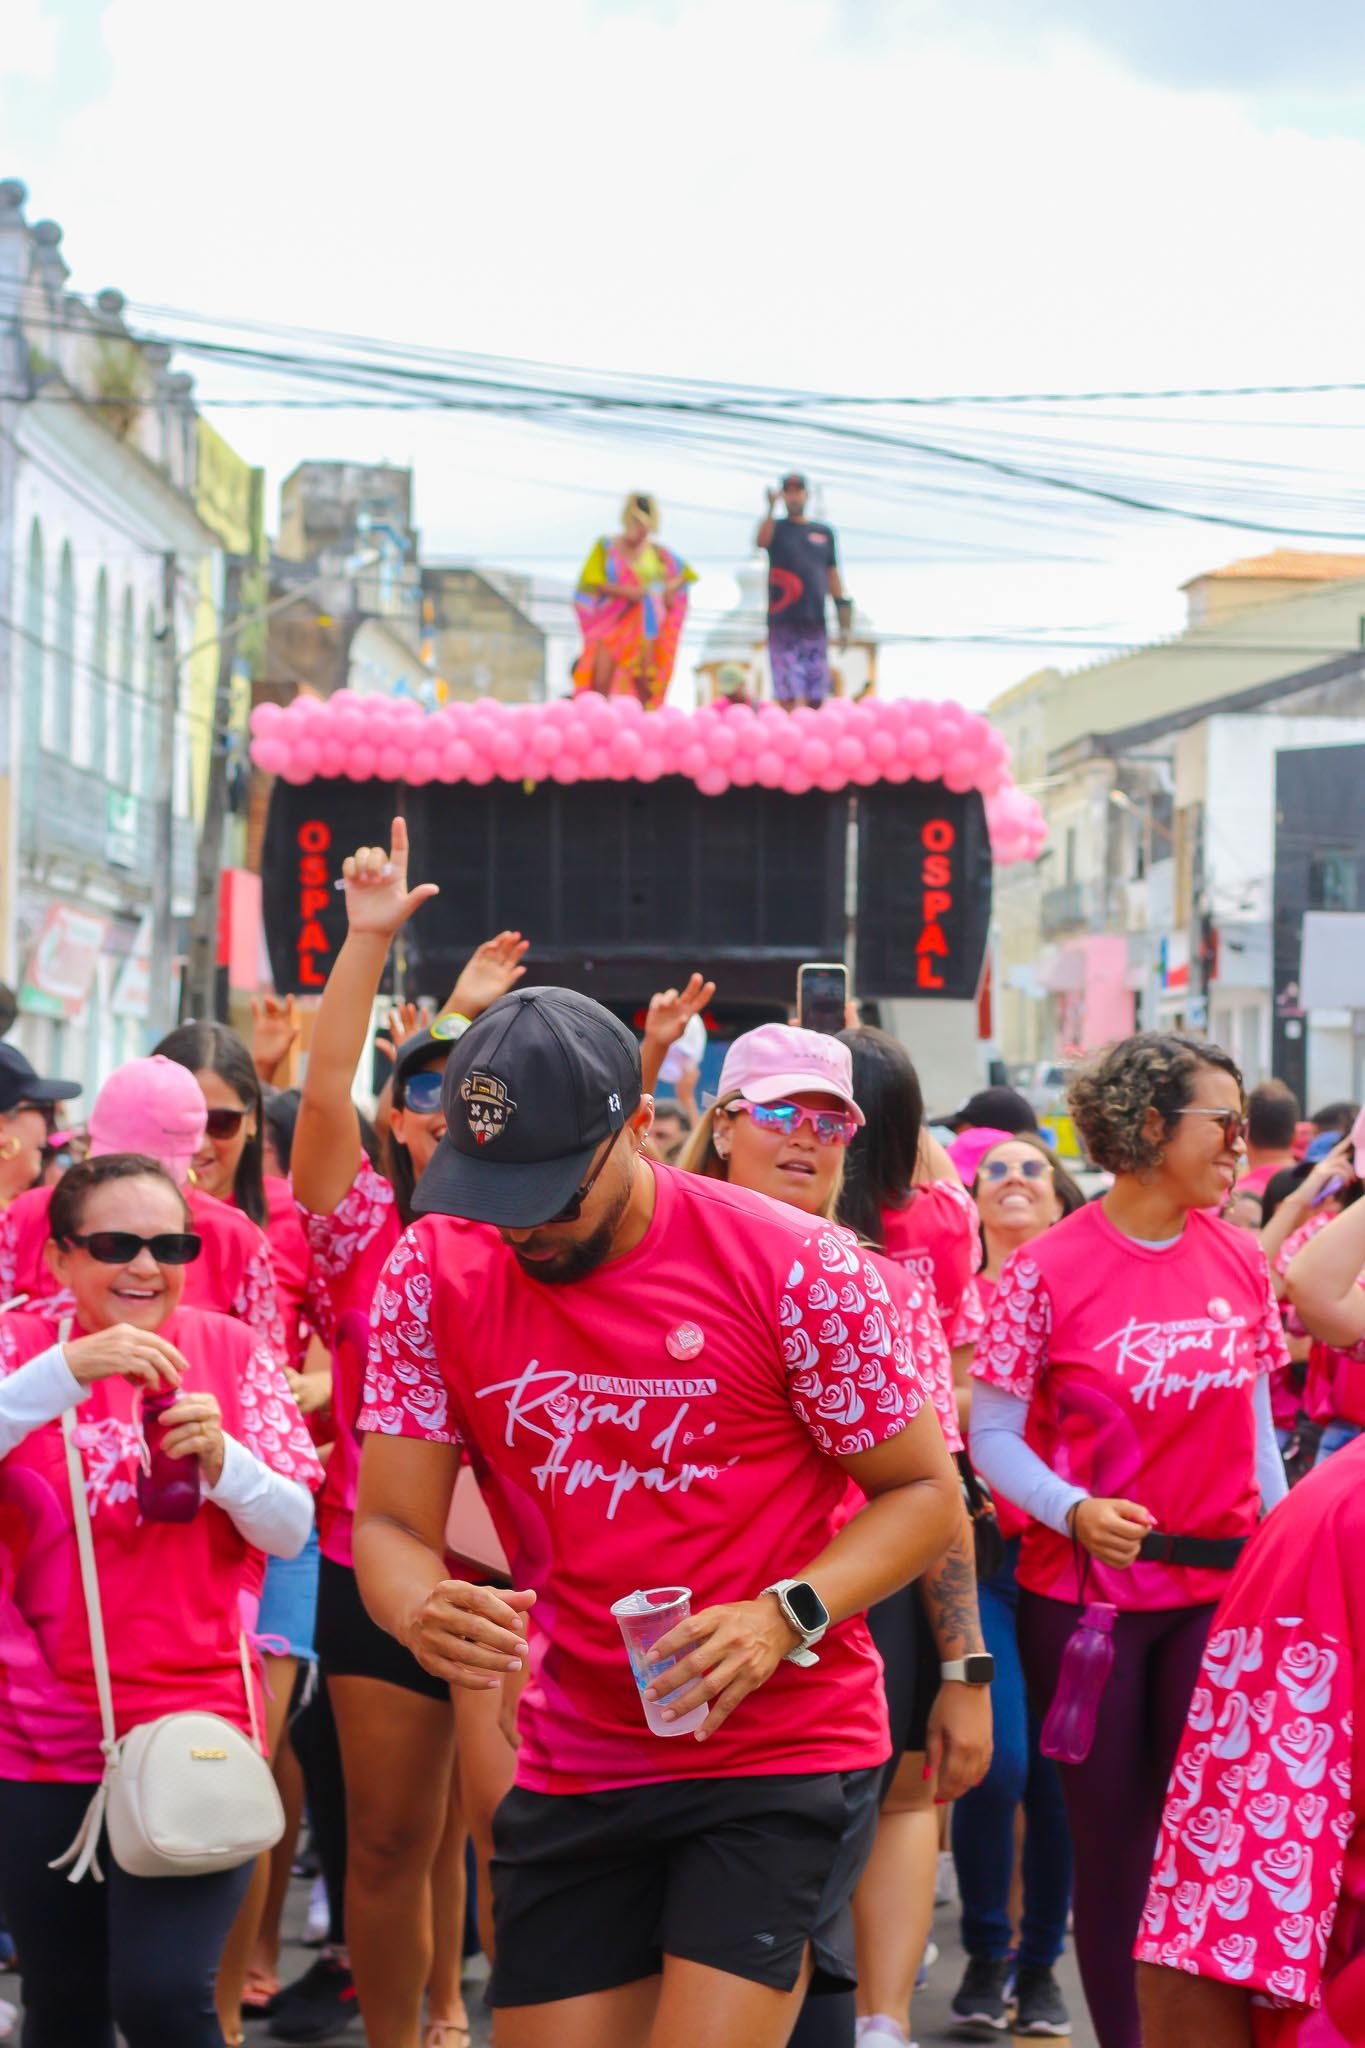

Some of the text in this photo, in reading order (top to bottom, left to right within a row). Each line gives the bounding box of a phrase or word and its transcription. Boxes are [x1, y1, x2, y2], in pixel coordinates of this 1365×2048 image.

[297, 819, 332, 987] OSPAL
[915, 818, 956, 990] OSPAL
[475, 1359, 647, 1447] Rosas
[596, 1376, 714, 1396] CAMINHADA
